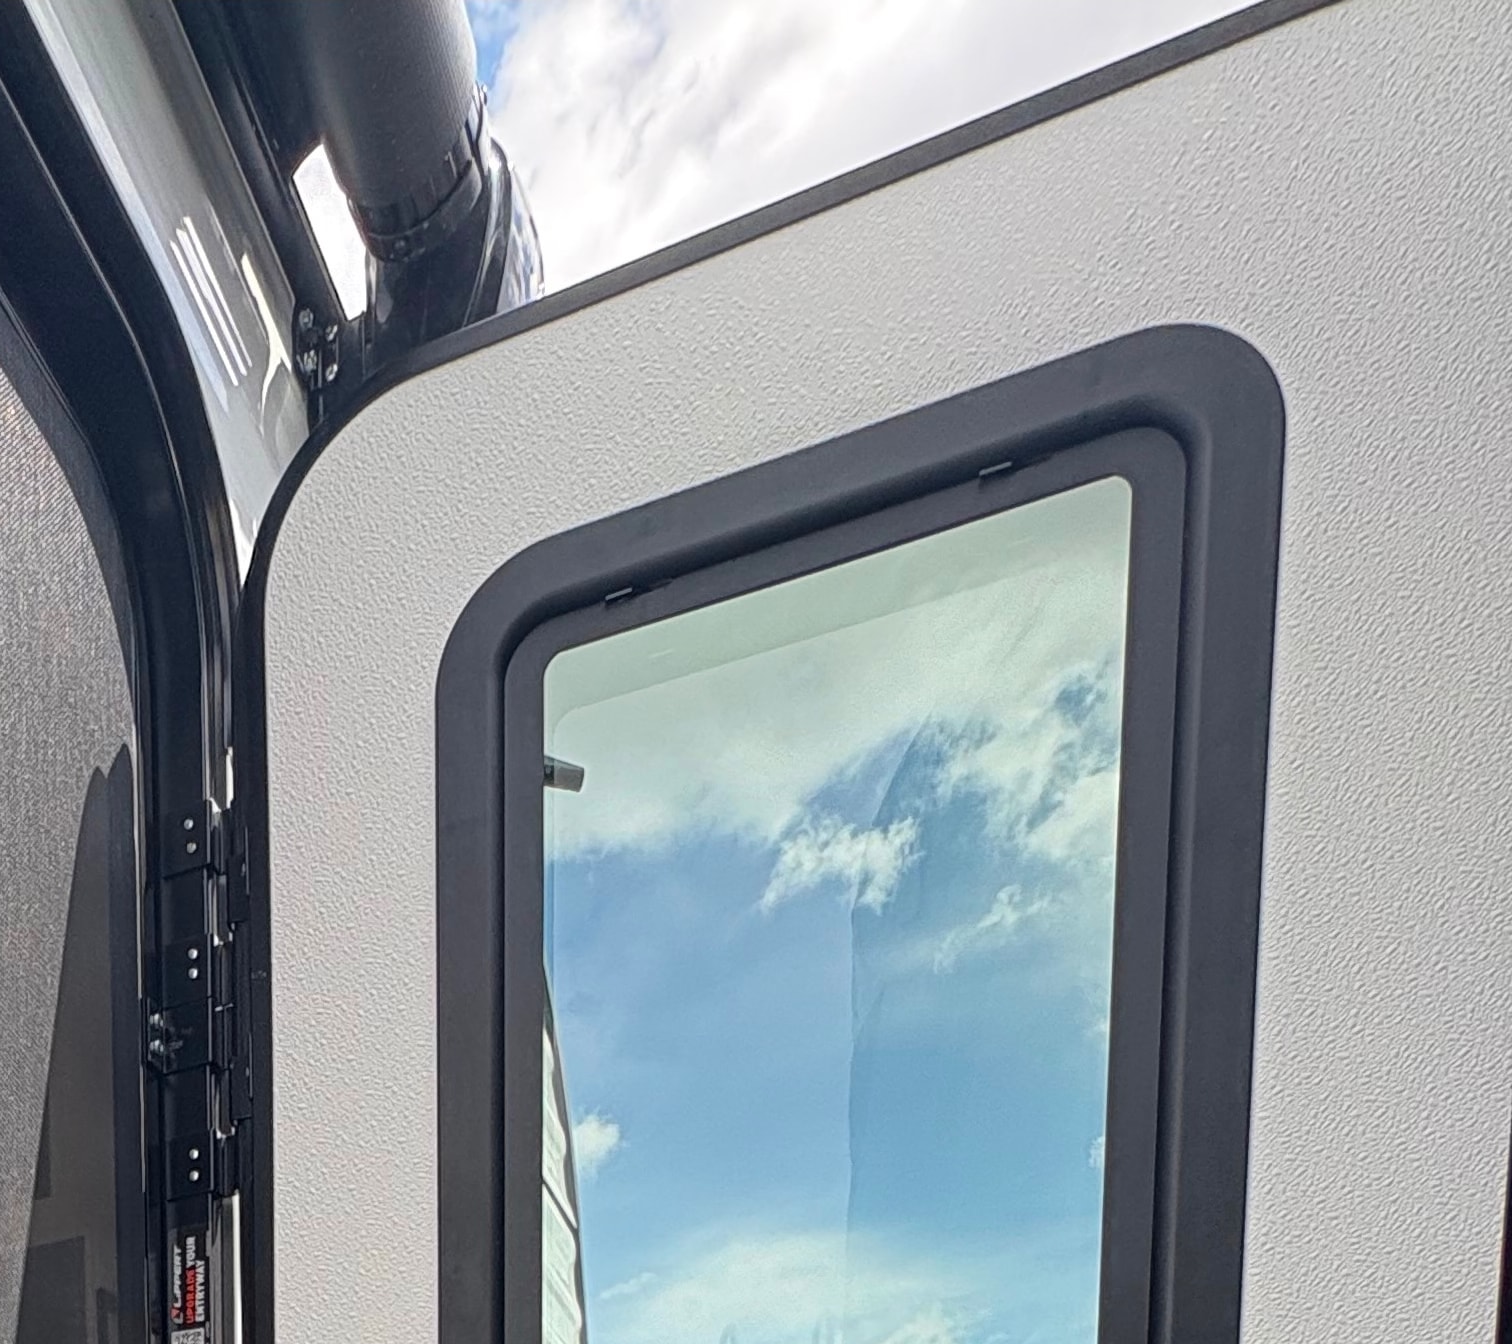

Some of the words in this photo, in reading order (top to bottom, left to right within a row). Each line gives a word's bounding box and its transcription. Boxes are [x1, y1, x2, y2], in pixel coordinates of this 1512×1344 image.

[173, 1244, 182, 1308] LIPPERT
[185, 1236, 196, 1268] YOUR
[185, 1269, 195, 1324] UPGRADE
[195, 1260, 205, 1322] ENTRYWAY
